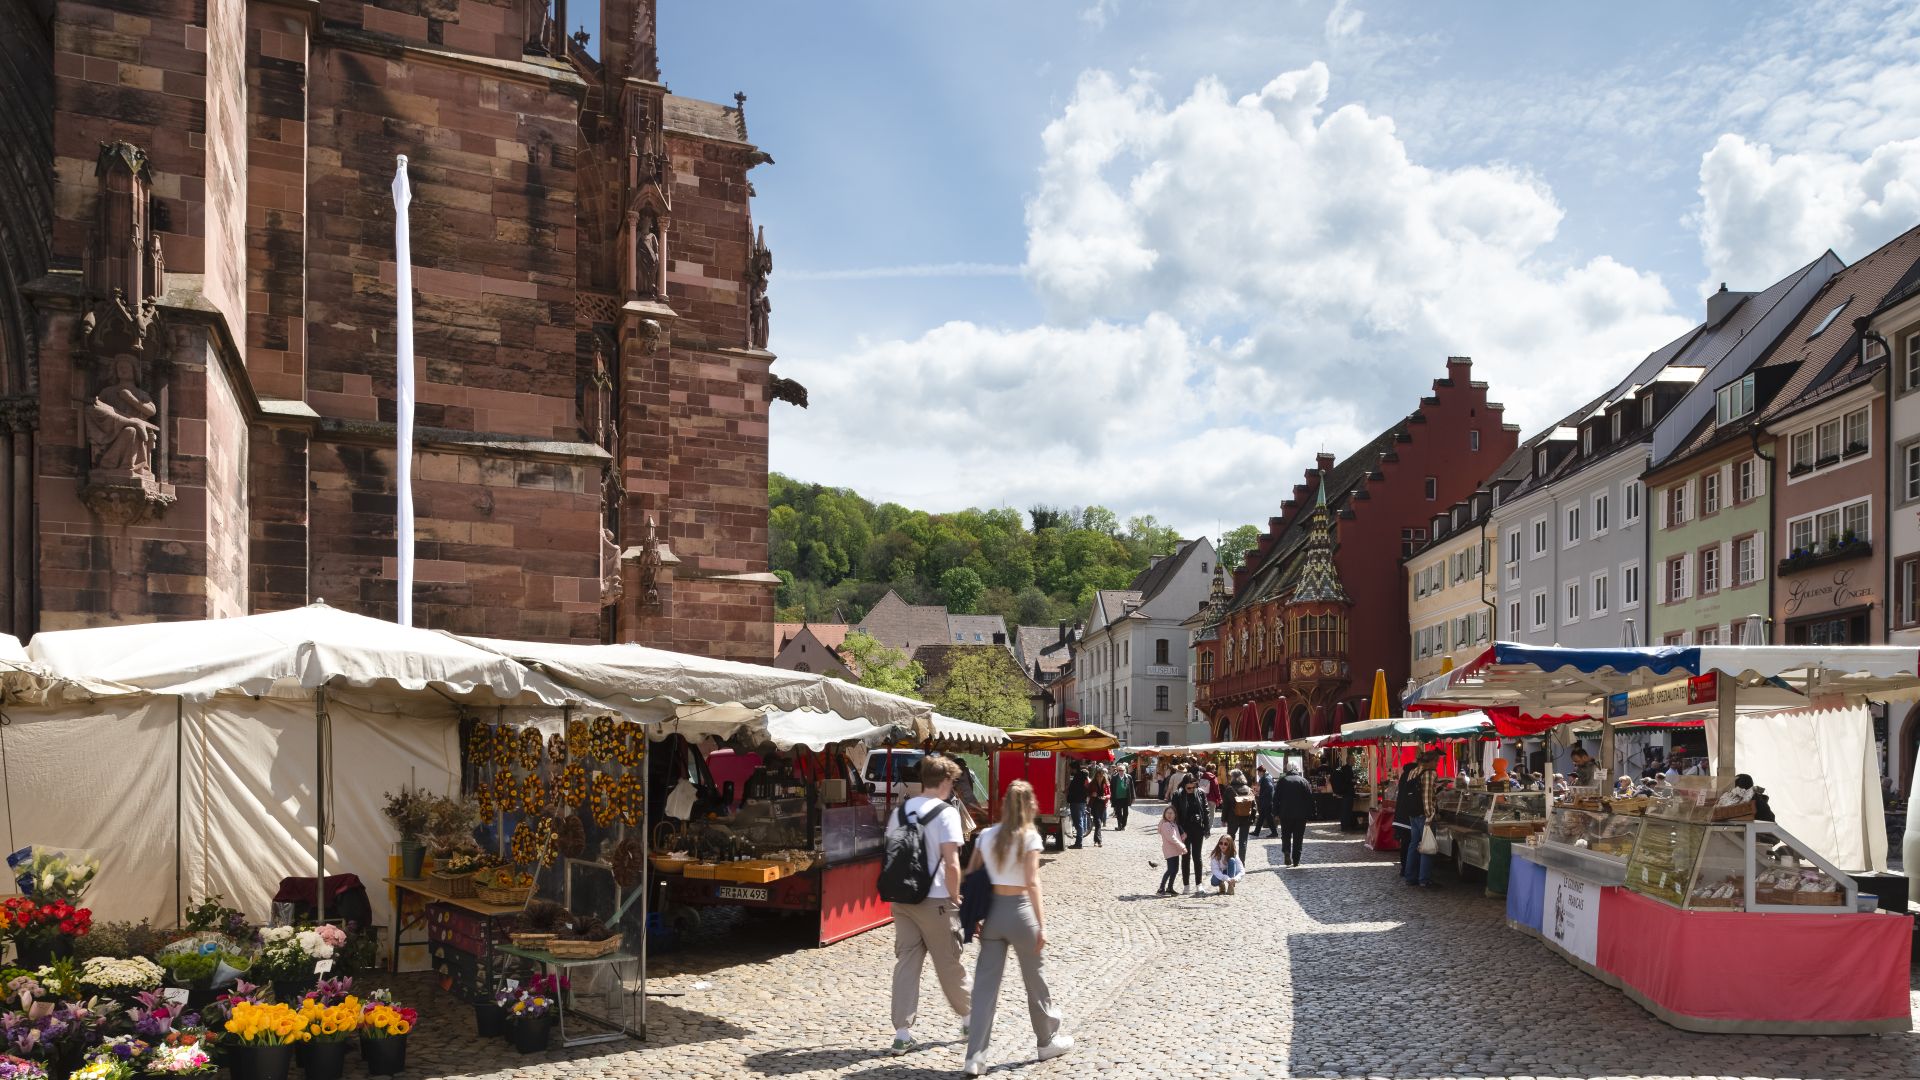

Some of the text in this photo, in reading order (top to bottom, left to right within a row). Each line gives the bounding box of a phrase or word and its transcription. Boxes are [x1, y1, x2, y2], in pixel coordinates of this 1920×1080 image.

[1149, 666, 1178, 675] MUSEUM
[720, 887, 767, 900] FR AX 493
